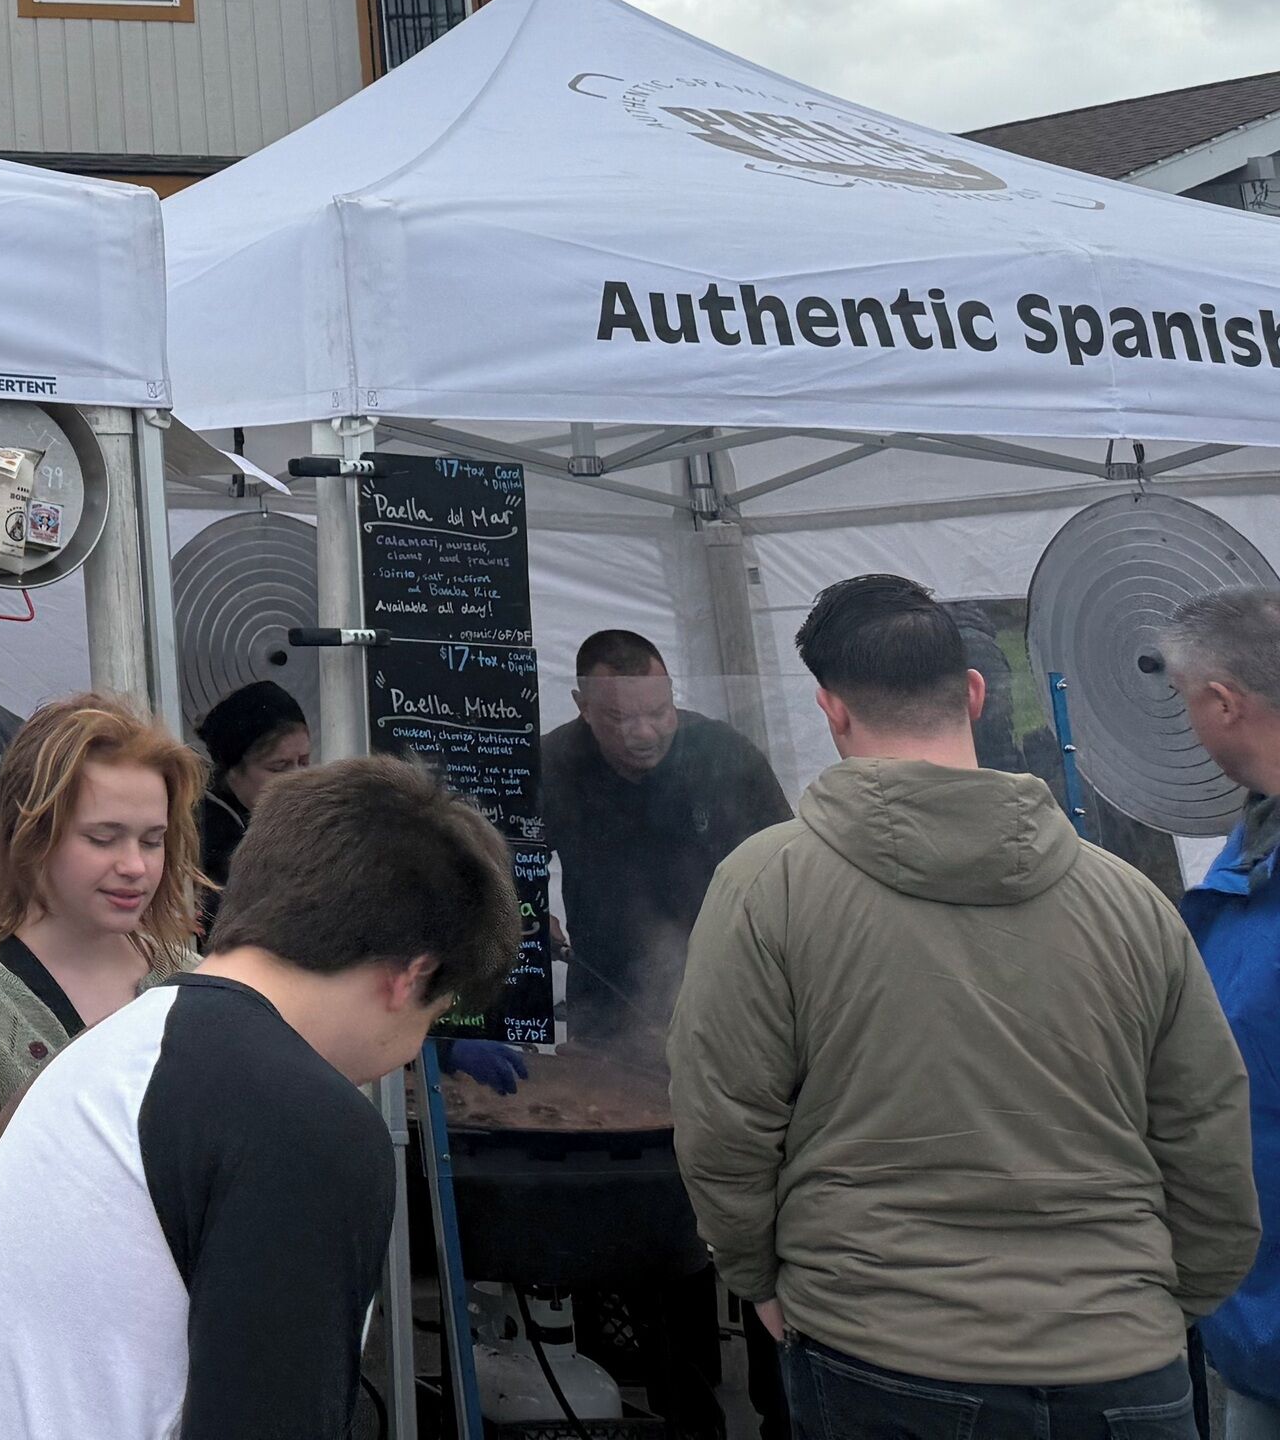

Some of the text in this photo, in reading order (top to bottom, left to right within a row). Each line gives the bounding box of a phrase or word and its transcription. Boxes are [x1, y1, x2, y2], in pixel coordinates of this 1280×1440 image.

[597, 281, 998, 353] Authentic
[373, 494, 514, 527] Paella del Mar
[474, 586, 502, 599] Rice
[375, 600, 493, 618] Available all day!
[390, 688, 522, 719] Paella Mixta
[450, 744, 470, 753] and
[514, 864, 548, 881] Digital
[507, 1028, 548, 1042] GF/DF
